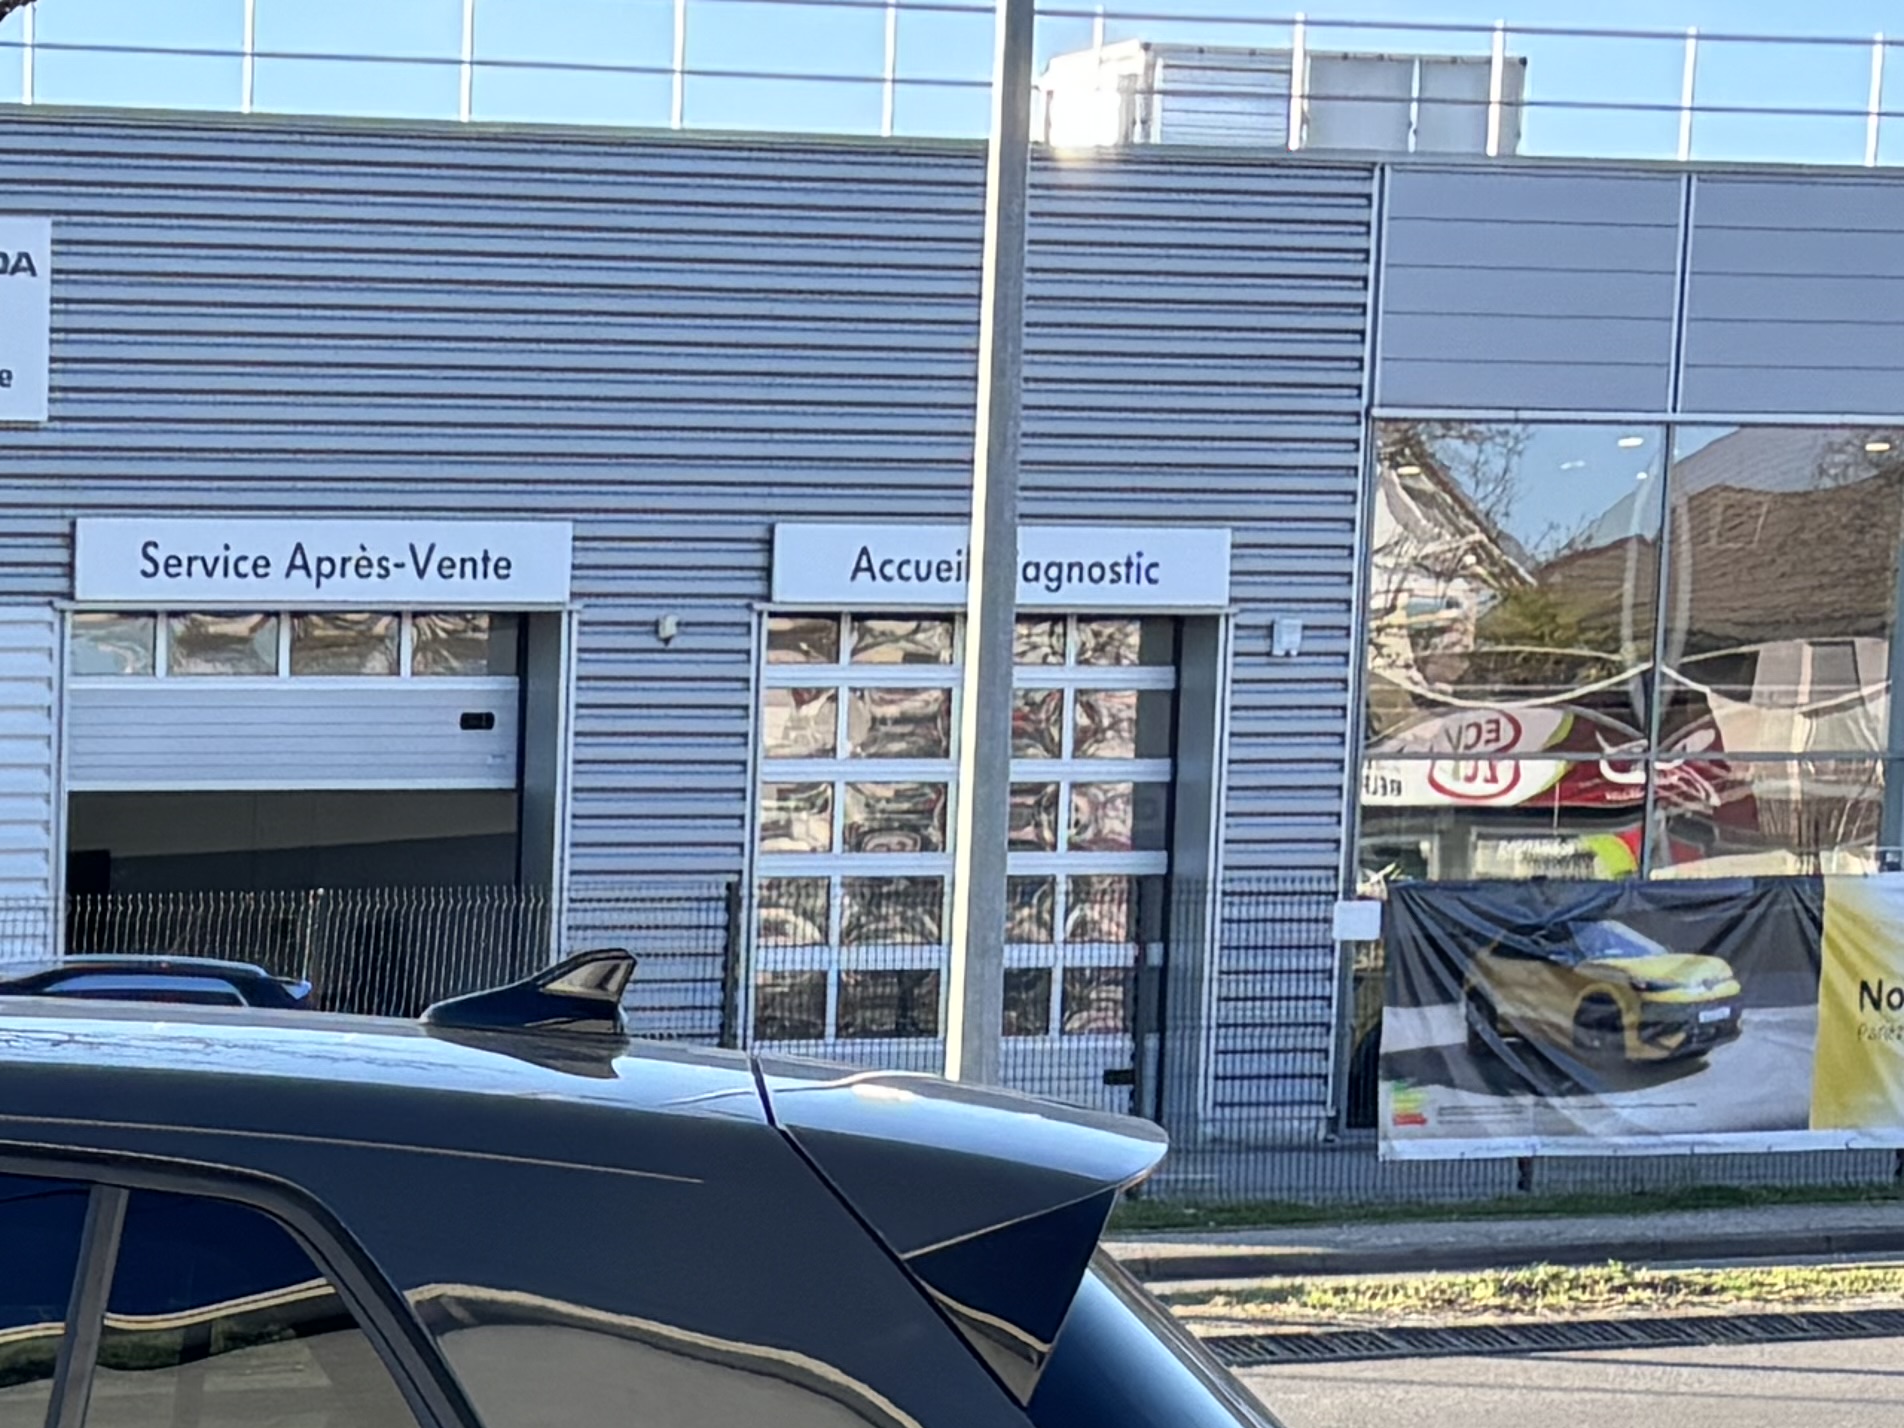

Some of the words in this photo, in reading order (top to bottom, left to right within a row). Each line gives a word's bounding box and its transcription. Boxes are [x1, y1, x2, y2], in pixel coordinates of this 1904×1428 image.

[140, 540, 271, 579] Service
[284, 541, 512, 590] Après-Vente
[1021, 550, 1160, 592] agnostic
